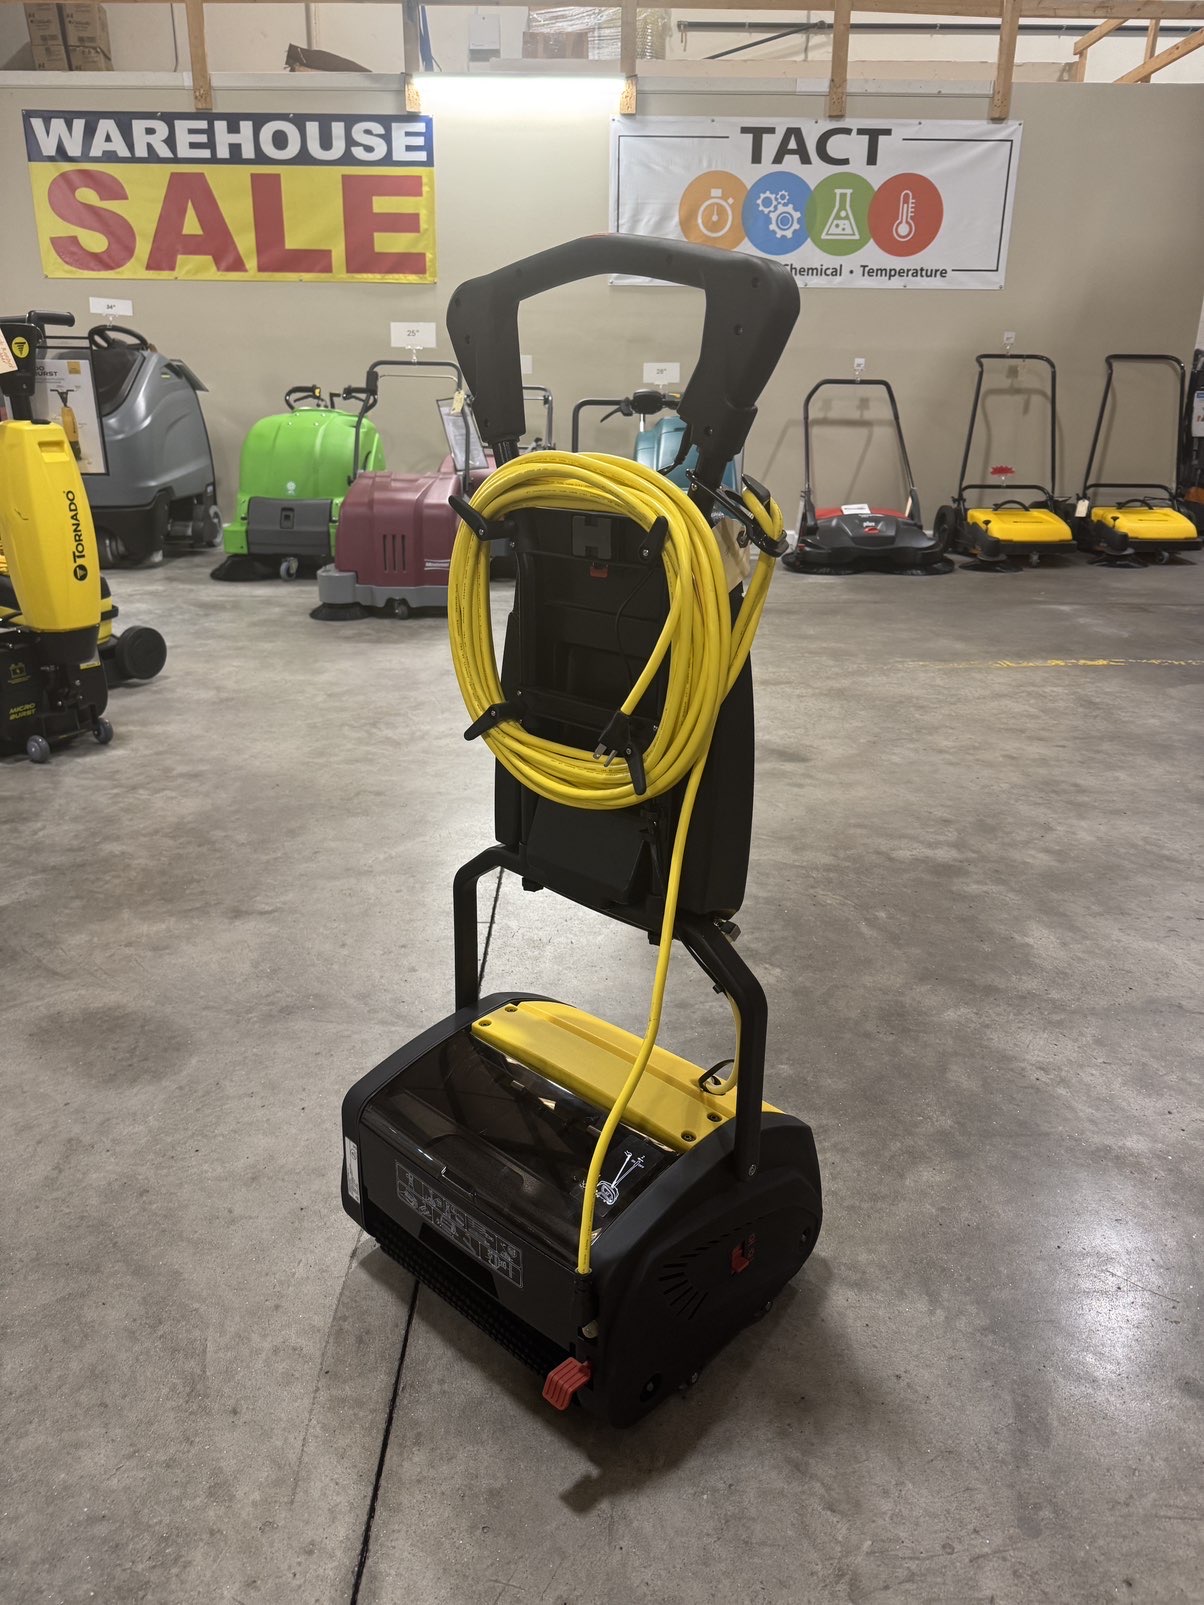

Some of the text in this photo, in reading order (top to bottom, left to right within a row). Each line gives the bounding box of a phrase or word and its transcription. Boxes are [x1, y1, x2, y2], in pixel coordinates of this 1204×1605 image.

[29, 117, 428, 162] WAREHOUSE
[740, 126, 892, 166] TACT
[47, 168, 427, 274] SALE
[783, 263, 948, 280] hemical Temperature
[406, 329, 420, 337] 25"
[66, 490, 86, 564] TORNADO
